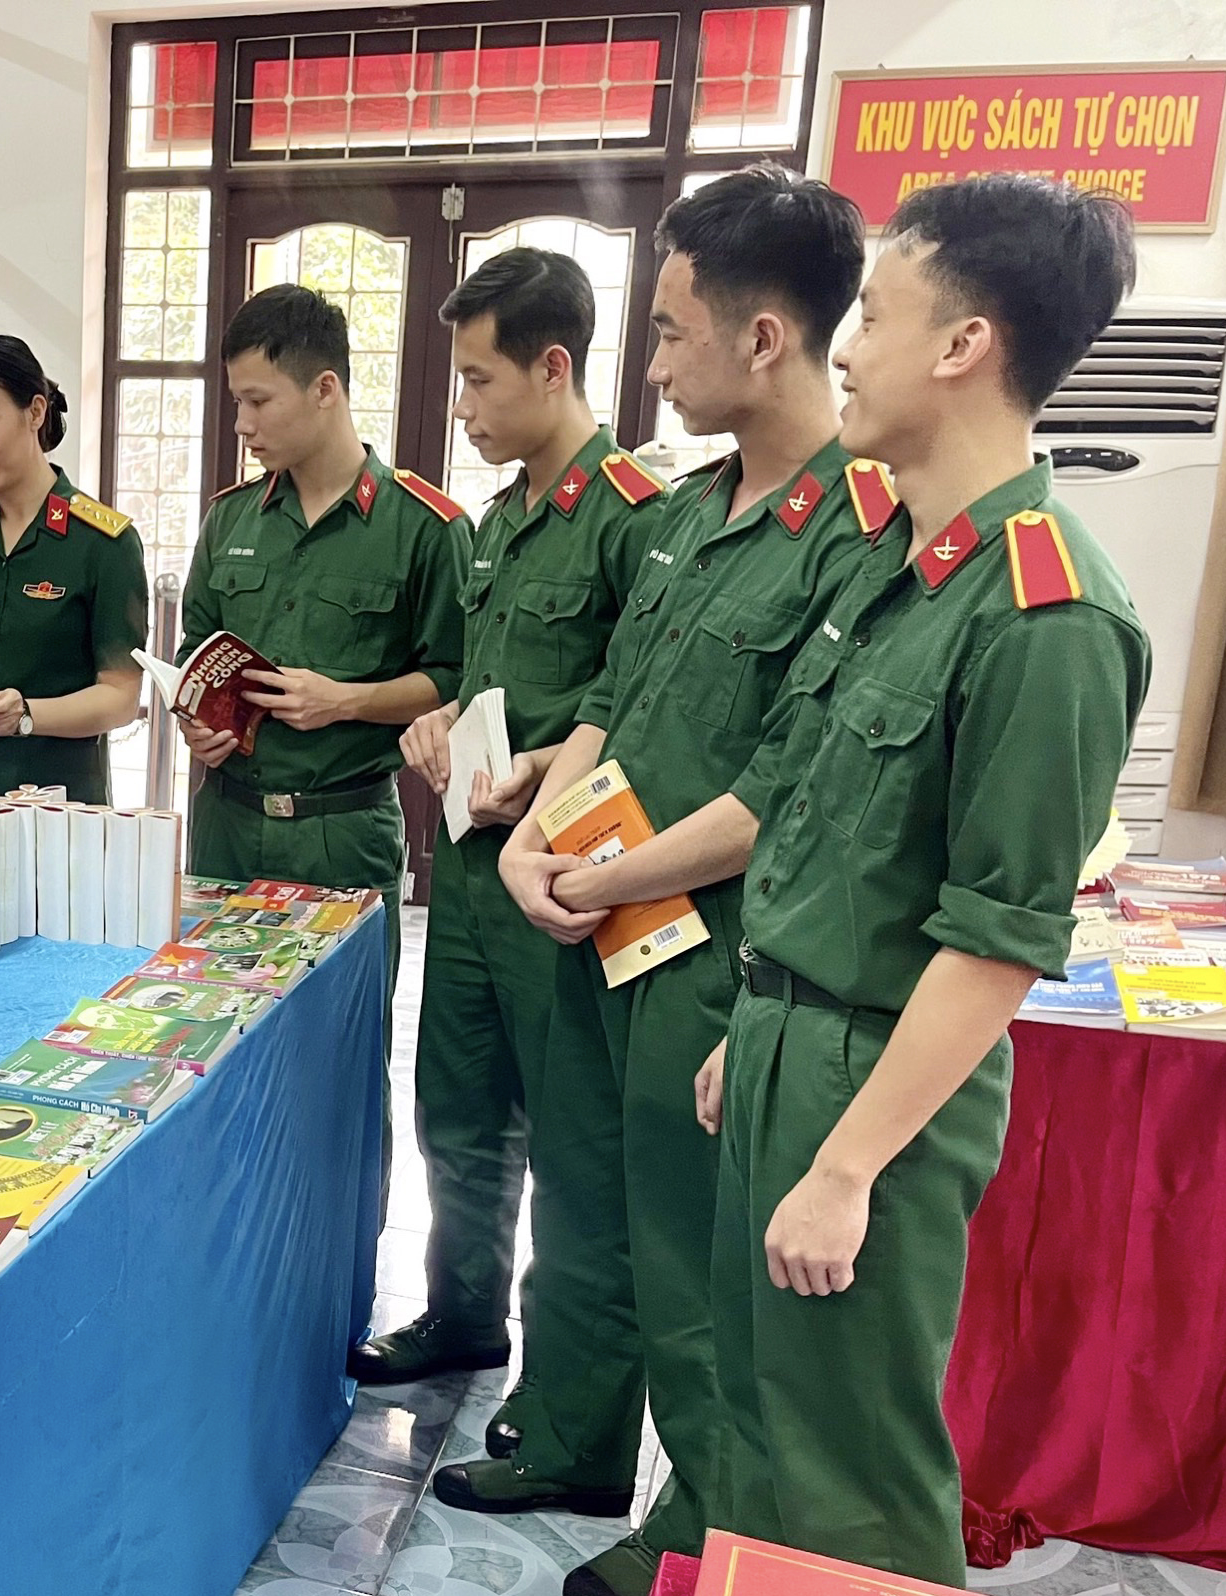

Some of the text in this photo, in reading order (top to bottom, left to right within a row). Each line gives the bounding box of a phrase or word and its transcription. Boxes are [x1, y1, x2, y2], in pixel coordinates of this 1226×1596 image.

[856, 89, 1199, 158] KHU VỰC SÁCH TỰ CHỌN
[29, 1069, 62, 1087] PHONG
[32, 1094, 57, 1105] PHONG
[58, 1098, 79, 1109] CÁCH
